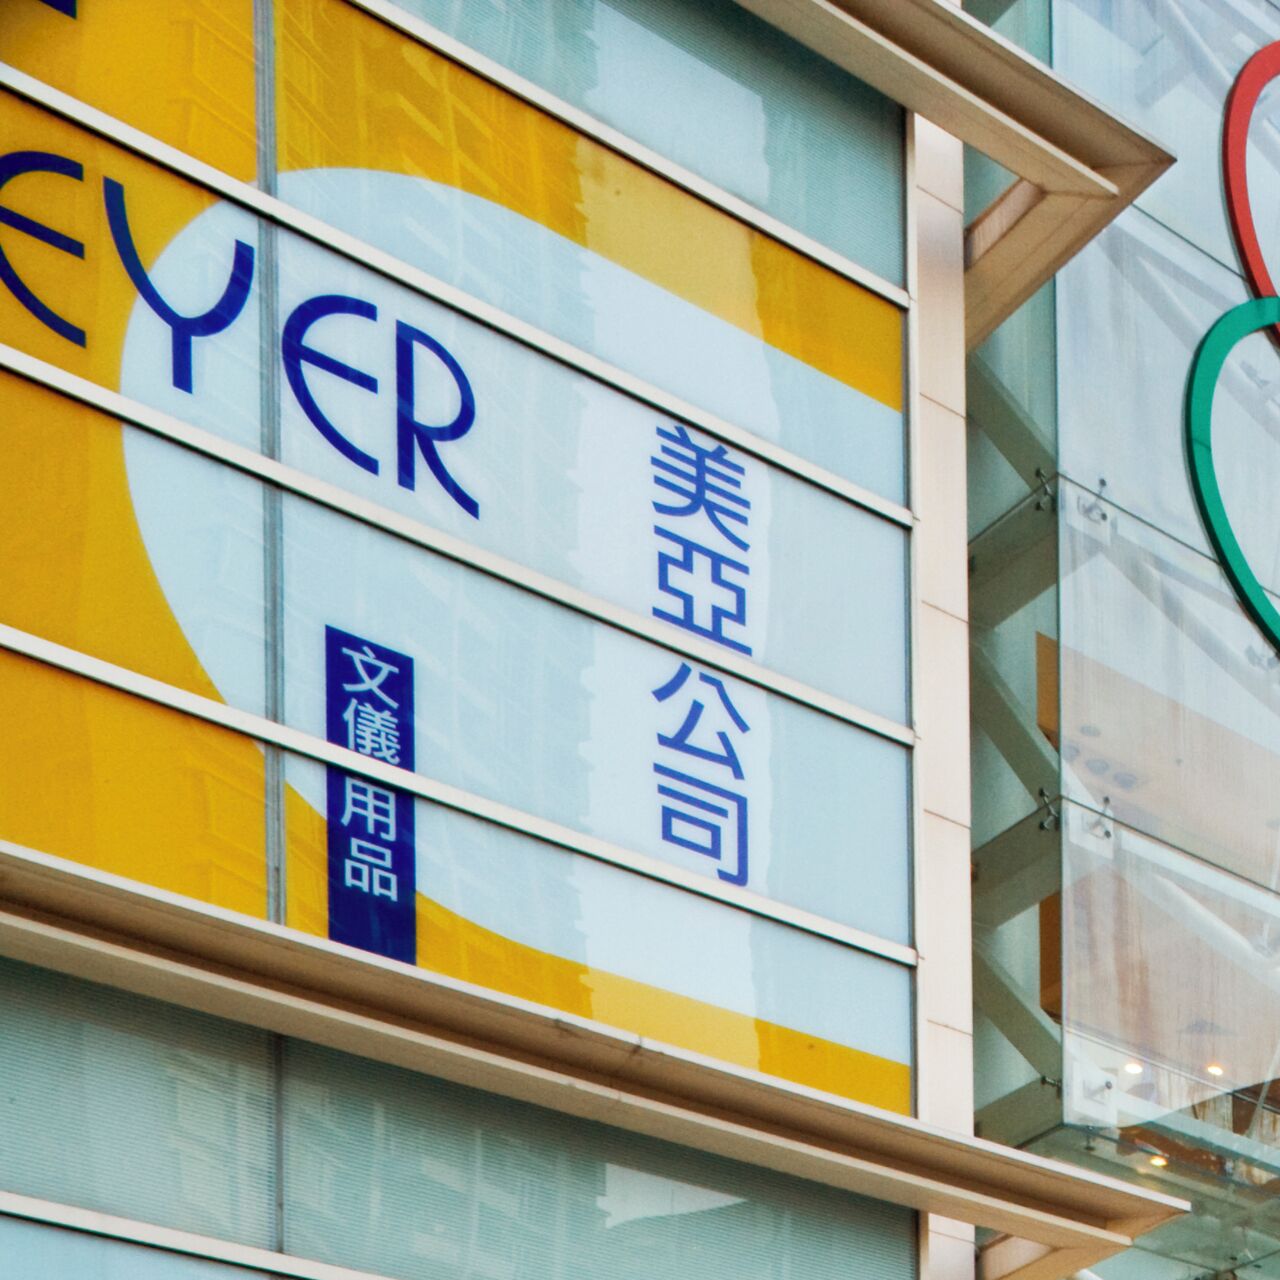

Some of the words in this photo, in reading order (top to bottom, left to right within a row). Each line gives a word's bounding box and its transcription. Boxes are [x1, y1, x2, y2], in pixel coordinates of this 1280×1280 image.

[340, 644, 401, 904] 文儀用品
[650, 424, 754, 888] 美亞公司
